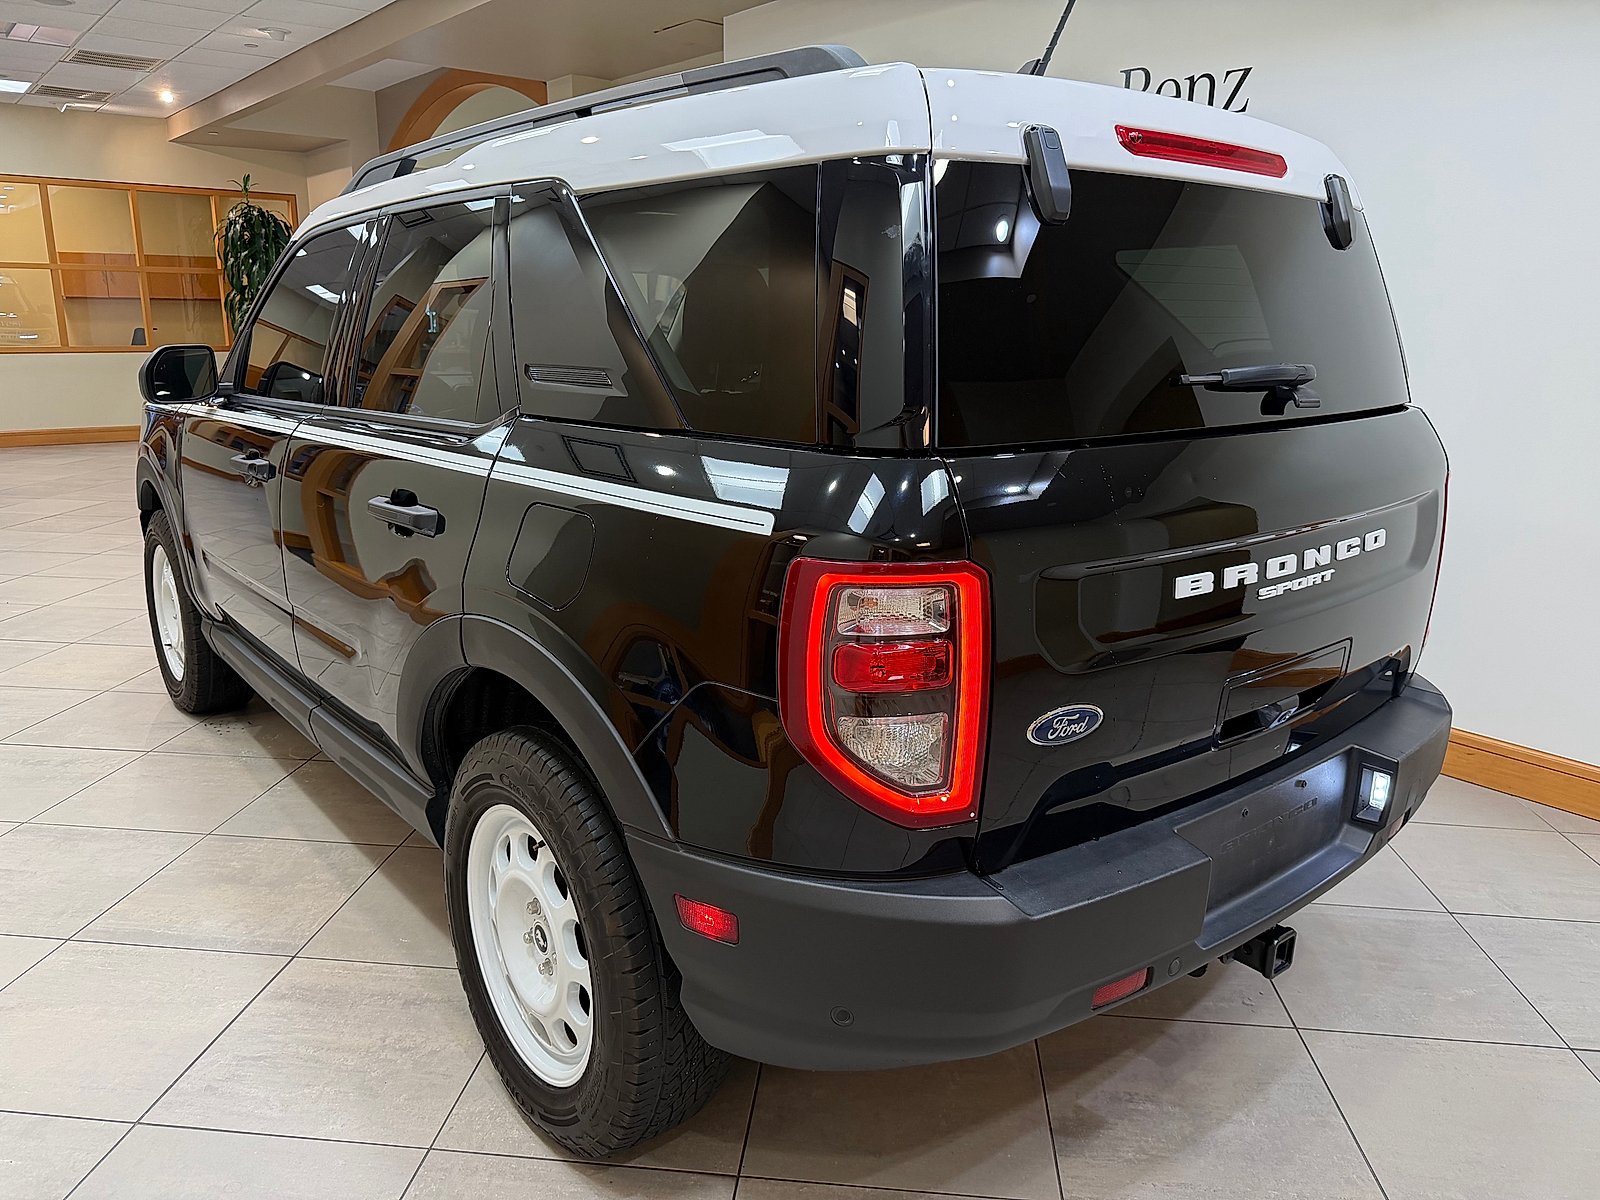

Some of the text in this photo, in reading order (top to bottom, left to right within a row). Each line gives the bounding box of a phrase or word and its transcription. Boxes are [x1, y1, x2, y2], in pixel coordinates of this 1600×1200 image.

[1174, 528, 1387, 600] BRONCO
[1257, 569, 1336, 600] SPORT
[1047, 713, 1090, 740] Ford
